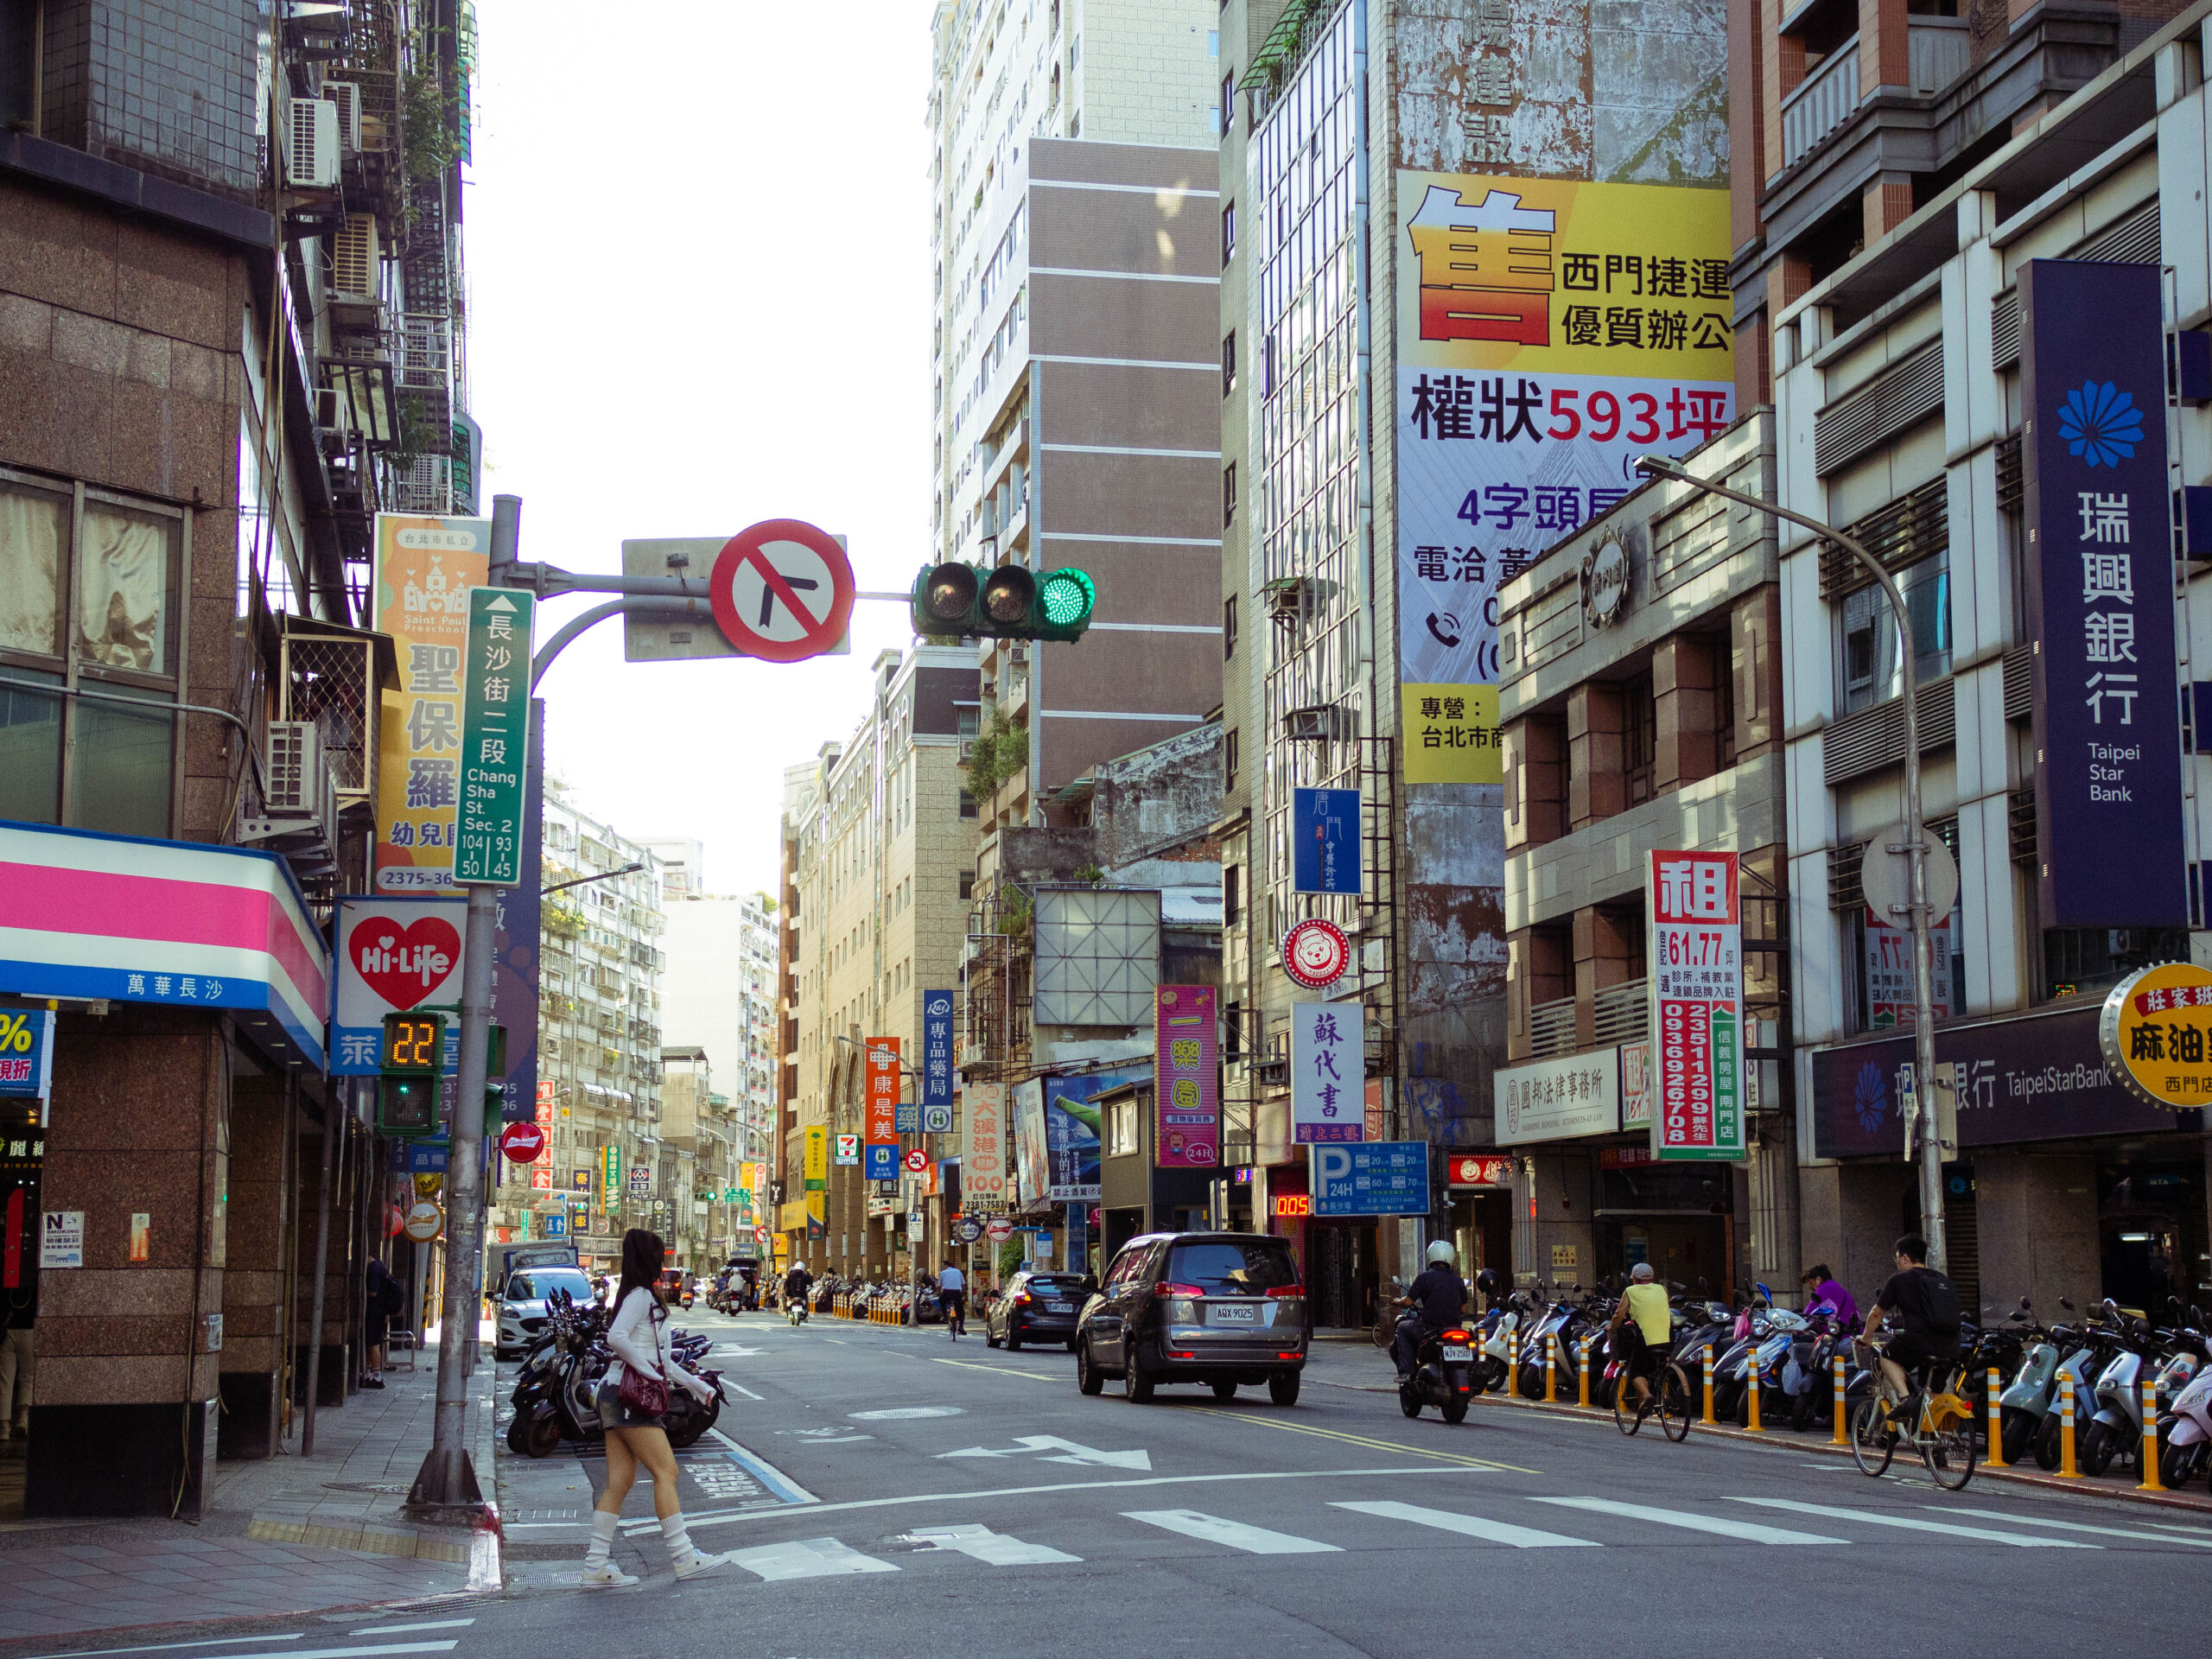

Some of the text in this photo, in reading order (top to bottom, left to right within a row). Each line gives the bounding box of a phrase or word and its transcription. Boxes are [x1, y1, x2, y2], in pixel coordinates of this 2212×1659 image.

[1408, 185, 1554, 346] 售
[1562, 252, 1730, 299] 西門捷運
[1562, 304, 1731, 352] 優質辦公
[1412, 373, 1726, 444] 權狀593坪
[404, 532, 469, 546] 台北市私立
[1414, 545, 1486, 582] 電洽
[404, 614, 467, 626] Saint Paul
[2078, 491, 2139, 725] 瑞興銀行
[479, 614, 514, 765] 長沙街二段
[407, 644, 460, 808] 聖保羅
[2088, 742, 2139, 766] Taipei
[467, 767, 516, 787] Chang
[2089, 764, 2124, 781] Star
[467, 784, 496, 799] Sha
[2089, 784, 2132, 803] Bank
[466, 800, 486, 816] St.
[1313, 791, 1343, 841] 唐門
[465, 817, 512, 833] Sec. 2
[461, 835, 512, 852] 104 93
[385, 871, 454, 886] 2375-36
[462, 861, 512, 878] 50 45
[1324, 841, 1337, 890] 中醫診所
[1660, 860, 1728, 918] 租
[1669, 931, 1722, 967] 61.77
[1725, 950, 1734, 966] 坪
[127, 974, 223, 1000] 萬華長沙
[1672, 985, 1735, 999] 連鎖品牌入駐
[2147, 986, 2212, 1012] 莊家班
[394, 1022, 435, 1064] 22
[2131, 1022, 2212, 1064] 麻油
[930, 1021, 946, 1097] 專品藥局
[1313, 1012, 1344, 1118] 蘇代書
[1718, 1030, 1733, 1090] 信義房屋
[2005, 1062, 2113, 1103] TaipeiStarBank
[874, 1075, 893, 1140] 康是美
[1719, 1095, 1734, 1139] 南門店
[973, 1100, 997, 1153] 大溪港
[1299, 1124, 1359, 1141] 請上二樓
[1188, 1148, 1211, 1158] 24H
[420, 1176, 435, 1190] Bar
[966, 1175, 1002, 1192] 100
[1317, 1147, 1351, 1198] P
[1330, 1182, 1353, 1197] 24H
[966, 1199, 1005, 1210] 2381-7587
[1276, 1197, 1309, 1216] 005
[1217, 1307, 1253, 1319] AQX-9025
